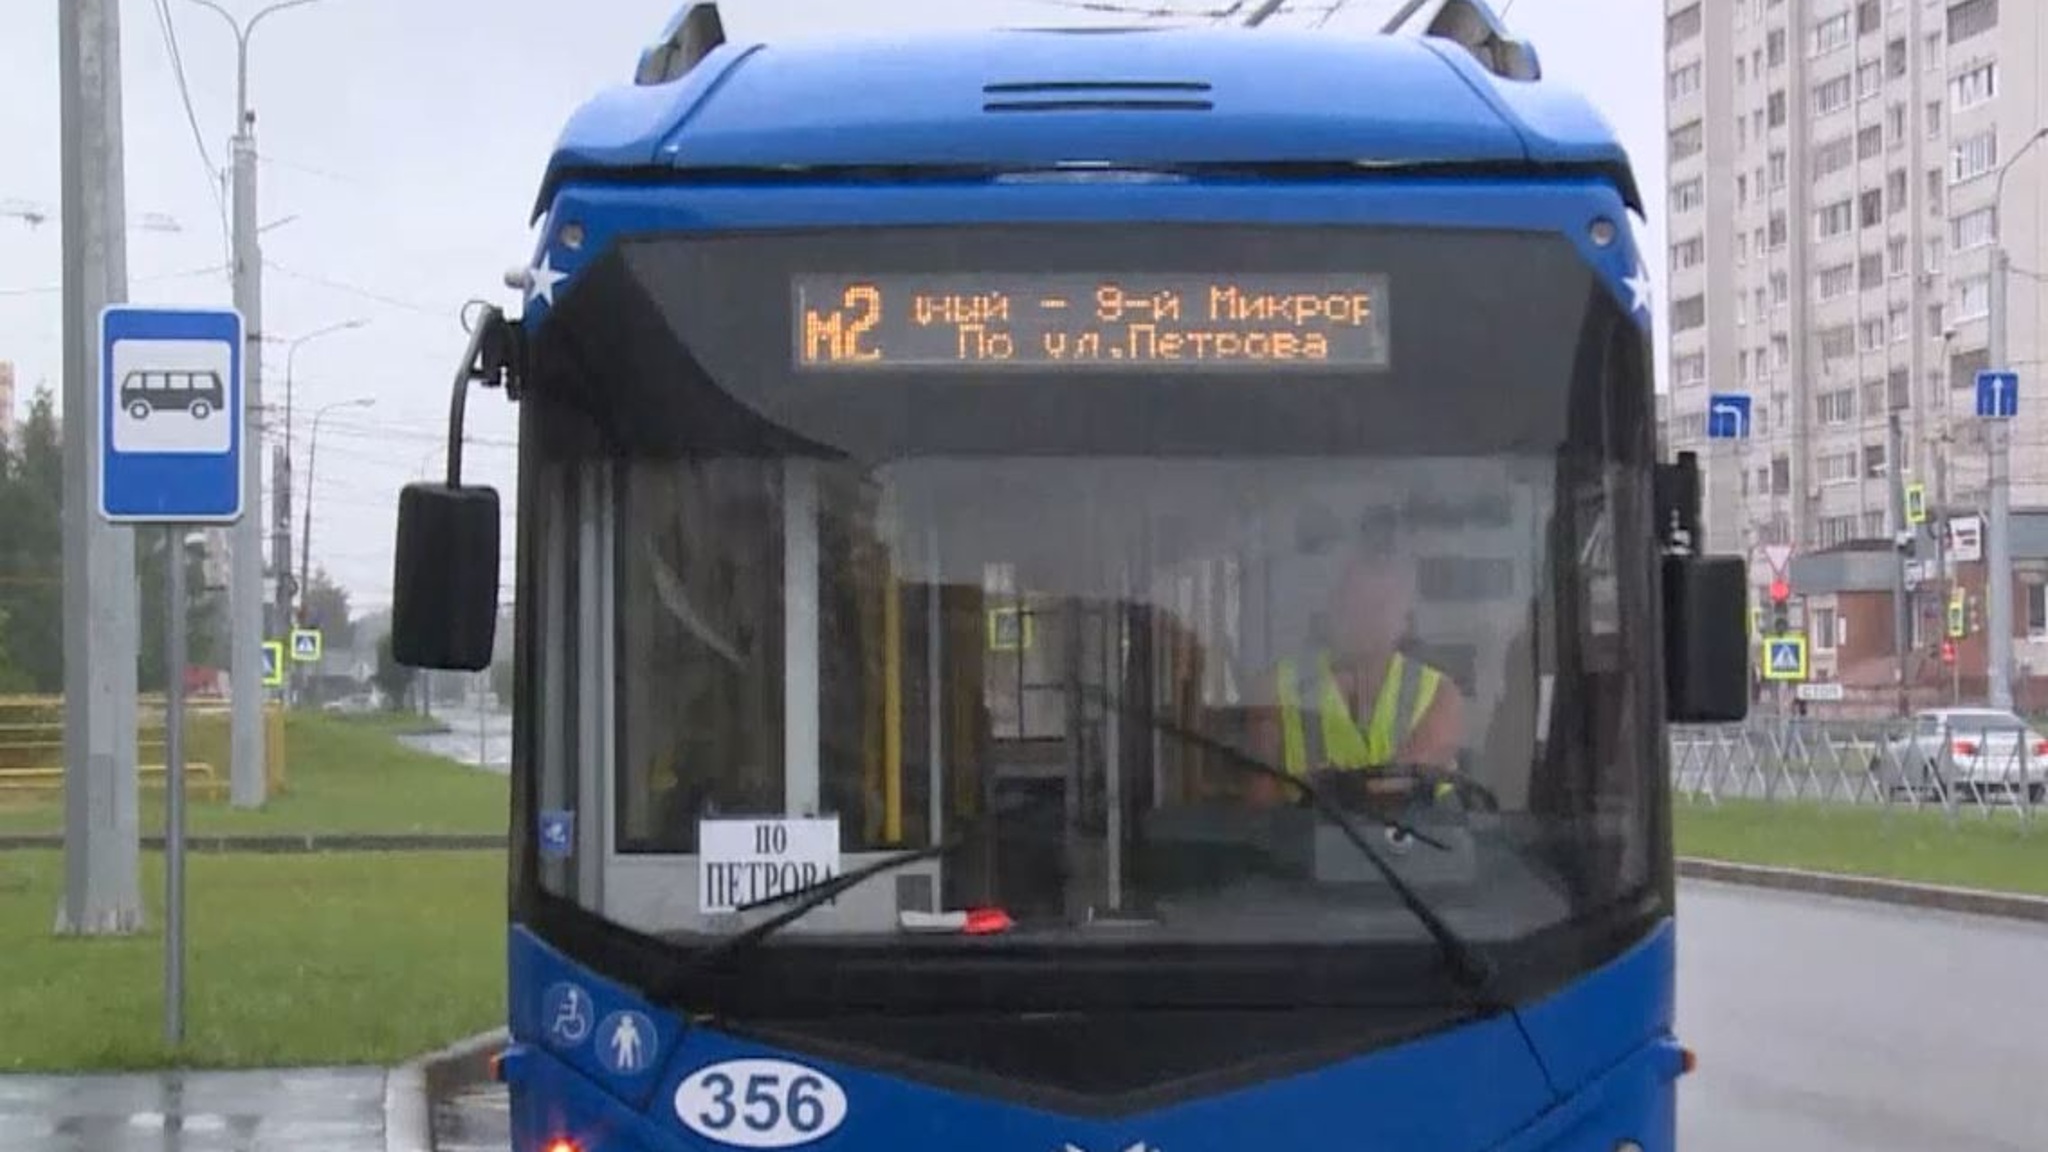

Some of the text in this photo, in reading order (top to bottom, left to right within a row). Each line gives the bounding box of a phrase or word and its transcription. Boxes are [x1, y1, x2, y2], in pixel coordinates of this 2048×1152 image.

[1096, 286, 1180, 322] 9-й
[958, 323, 1013, 360] По
[756, 824, 787, 854] ПО
[699, 1073, 825, 1132] 356
